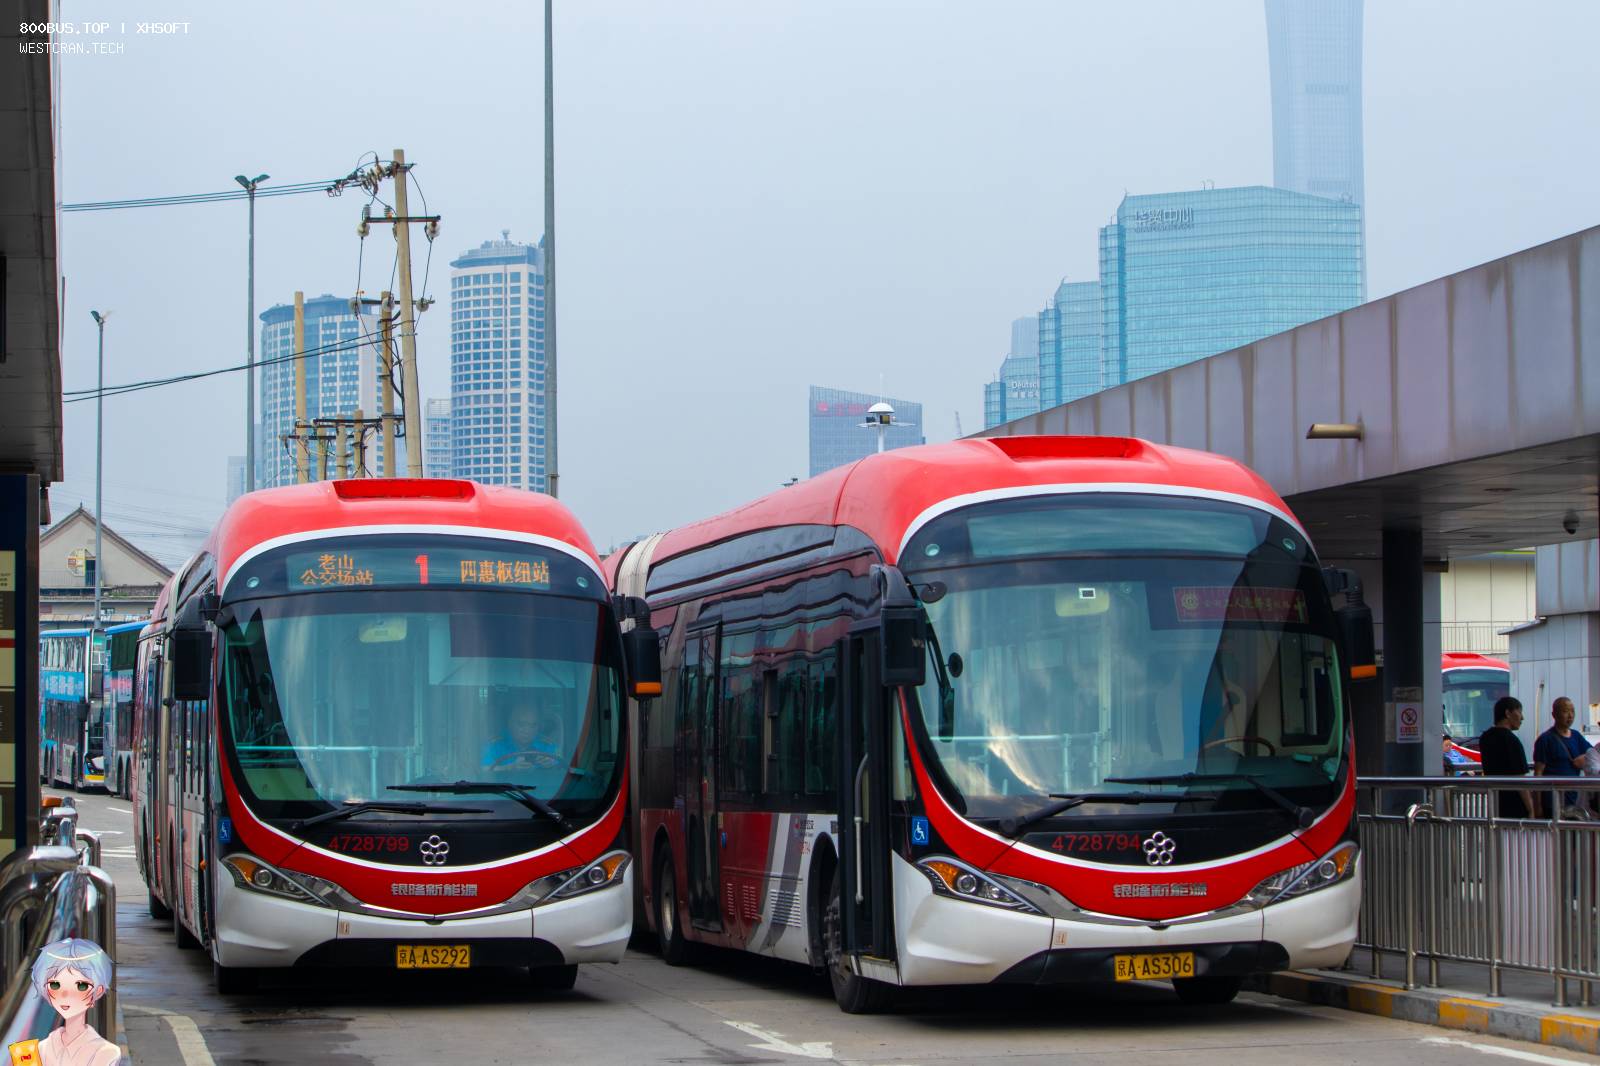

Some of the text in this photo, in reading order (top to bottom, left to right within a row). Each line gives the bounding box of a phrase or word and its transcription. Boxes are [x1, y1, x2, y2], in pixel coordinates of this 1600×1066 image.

[319, 554, 353, 575] 老山
[415, 555, 429, 584] 1
[461, 559, 549, 584] 四惠枢纽站
[299, 568, 374, 586] 公交场站
[328, 836, 409, 852] 4728799
[1052, 833, 1141, 851] 4728794
[391, 883, 478, 897] 银隆新能源
[1113, 882, 1208, 898] 银隆新能源
